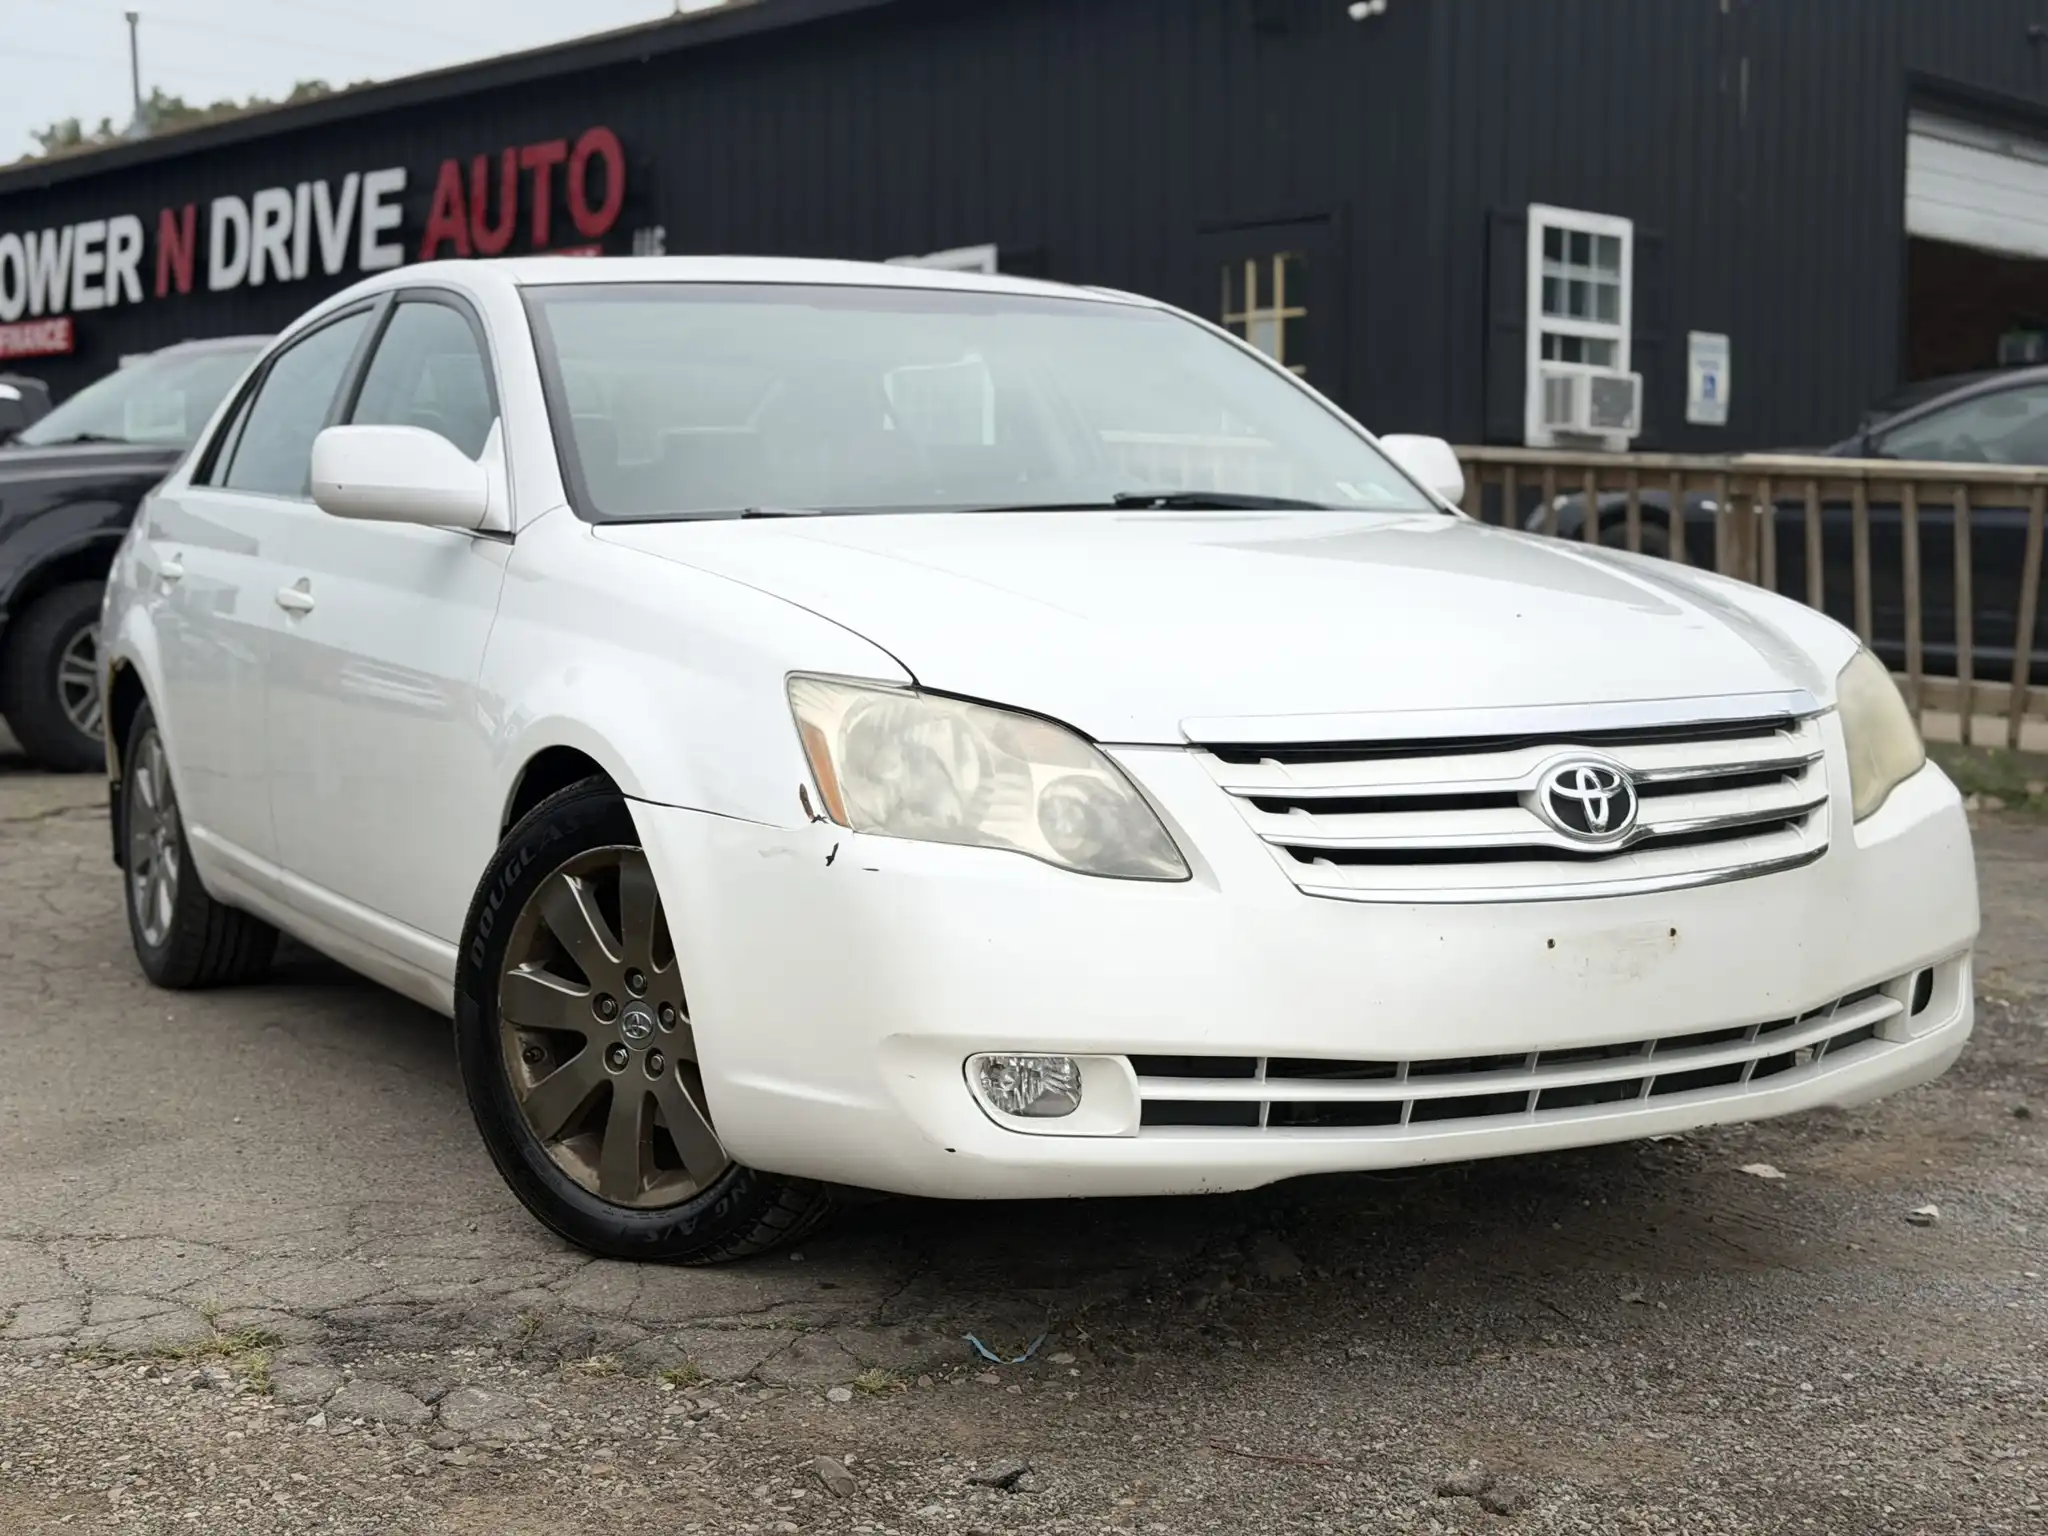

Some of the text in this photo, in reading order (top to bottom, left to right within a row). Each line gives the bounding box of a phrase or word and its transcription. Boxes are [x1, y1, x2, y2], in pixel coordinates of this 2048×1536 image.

[155, 203, 196, 297] N
[208, 166, 406, 292] DRIVE
[418, 126, 625, 261] AUTO
[470, 811, 583, 972] DOUGLAS
